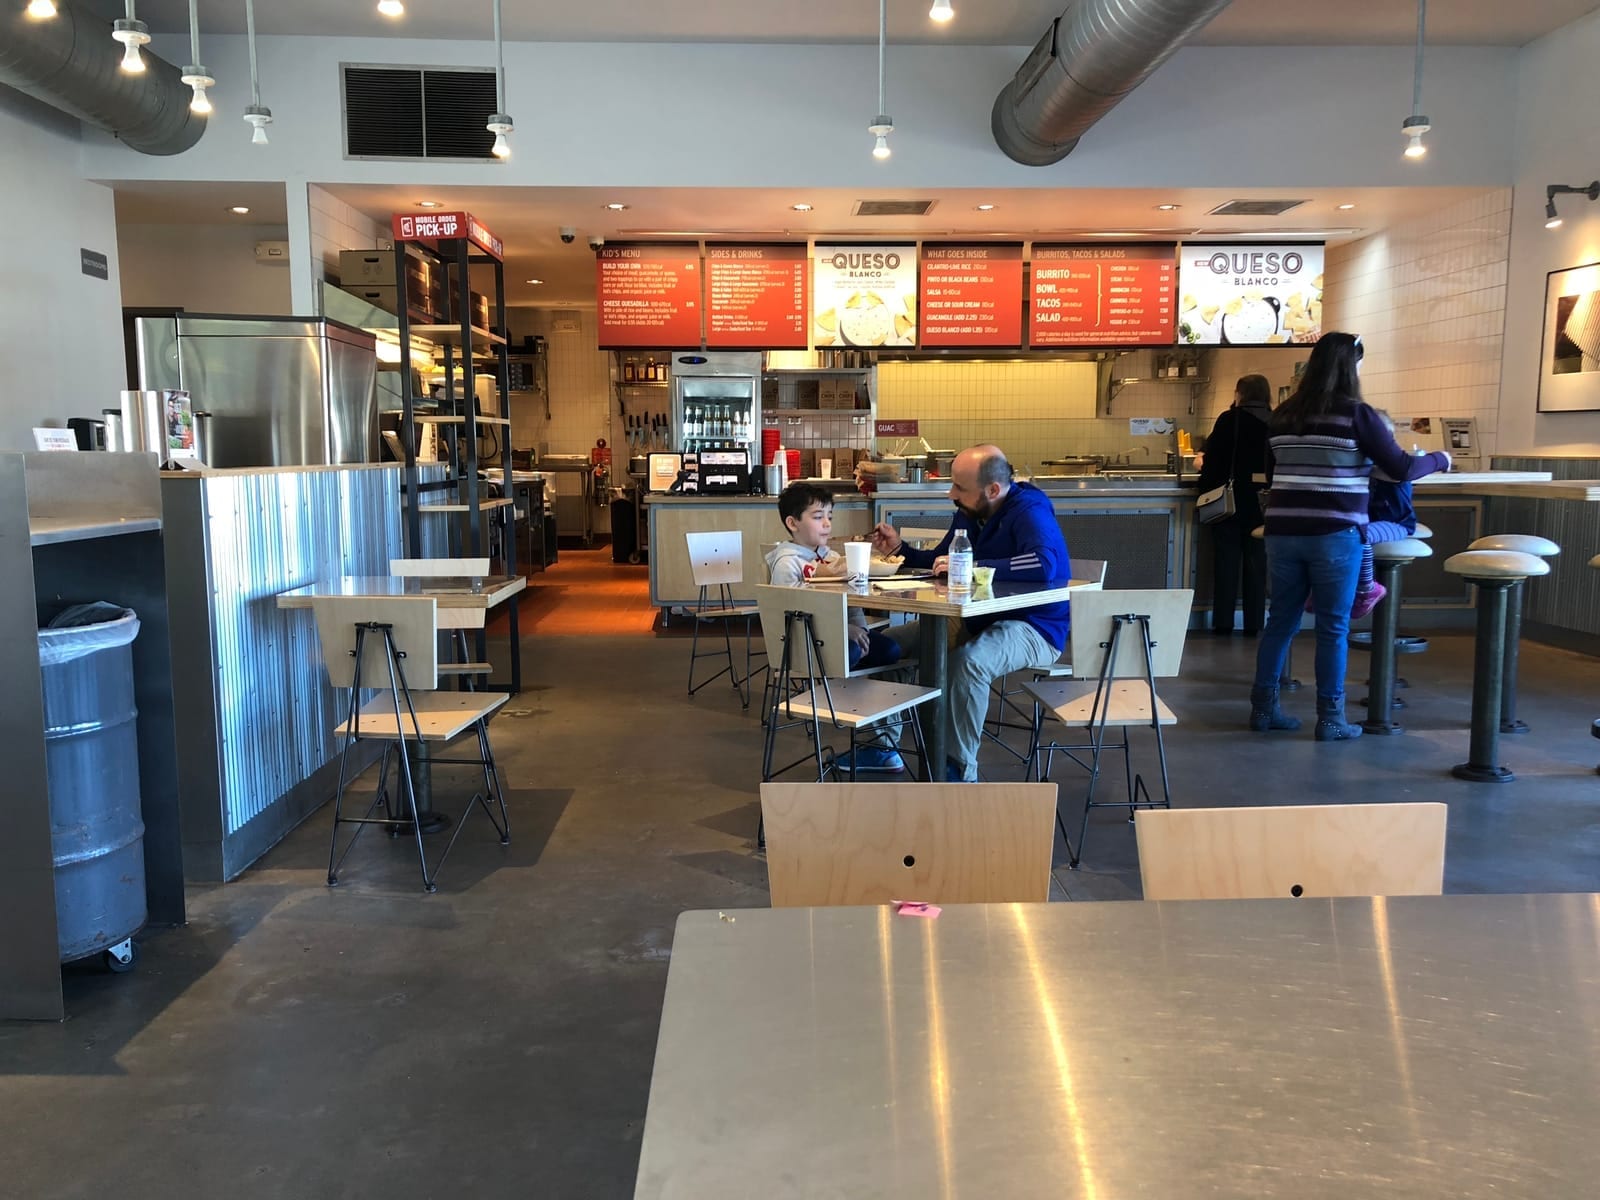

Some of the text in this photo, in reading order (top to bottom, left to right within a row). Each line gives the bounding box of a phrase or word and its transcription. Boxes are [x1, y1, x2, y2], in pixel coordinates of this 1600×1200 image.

[438, 215, 457, 223] ORDER
[416, 223, 458, 236] PICK-UP
[602, 249, 641, 258] KID'S MENU
[711, 250, 763, 258] SIDES & DRINKS
[927, 250, 988, 258] WHAT GOES INSIDE
[1036, 250, 1126, 259] BURRITOS, TACOS & SALADS
[832, 253, 900, 269] QUESO
[1209, 252, 1303, 274] QUESO
[1036, 269, 1070, 279] BURRITO
[1234, 277, 1278, 286] BLANCO
[1036, 284, 1058, 294] BOWL
[1036, 298, 1061, 308] TACOS
[1036, 313, 1061, 322] SALAD
[878, 424, 895, 432] GUAC
